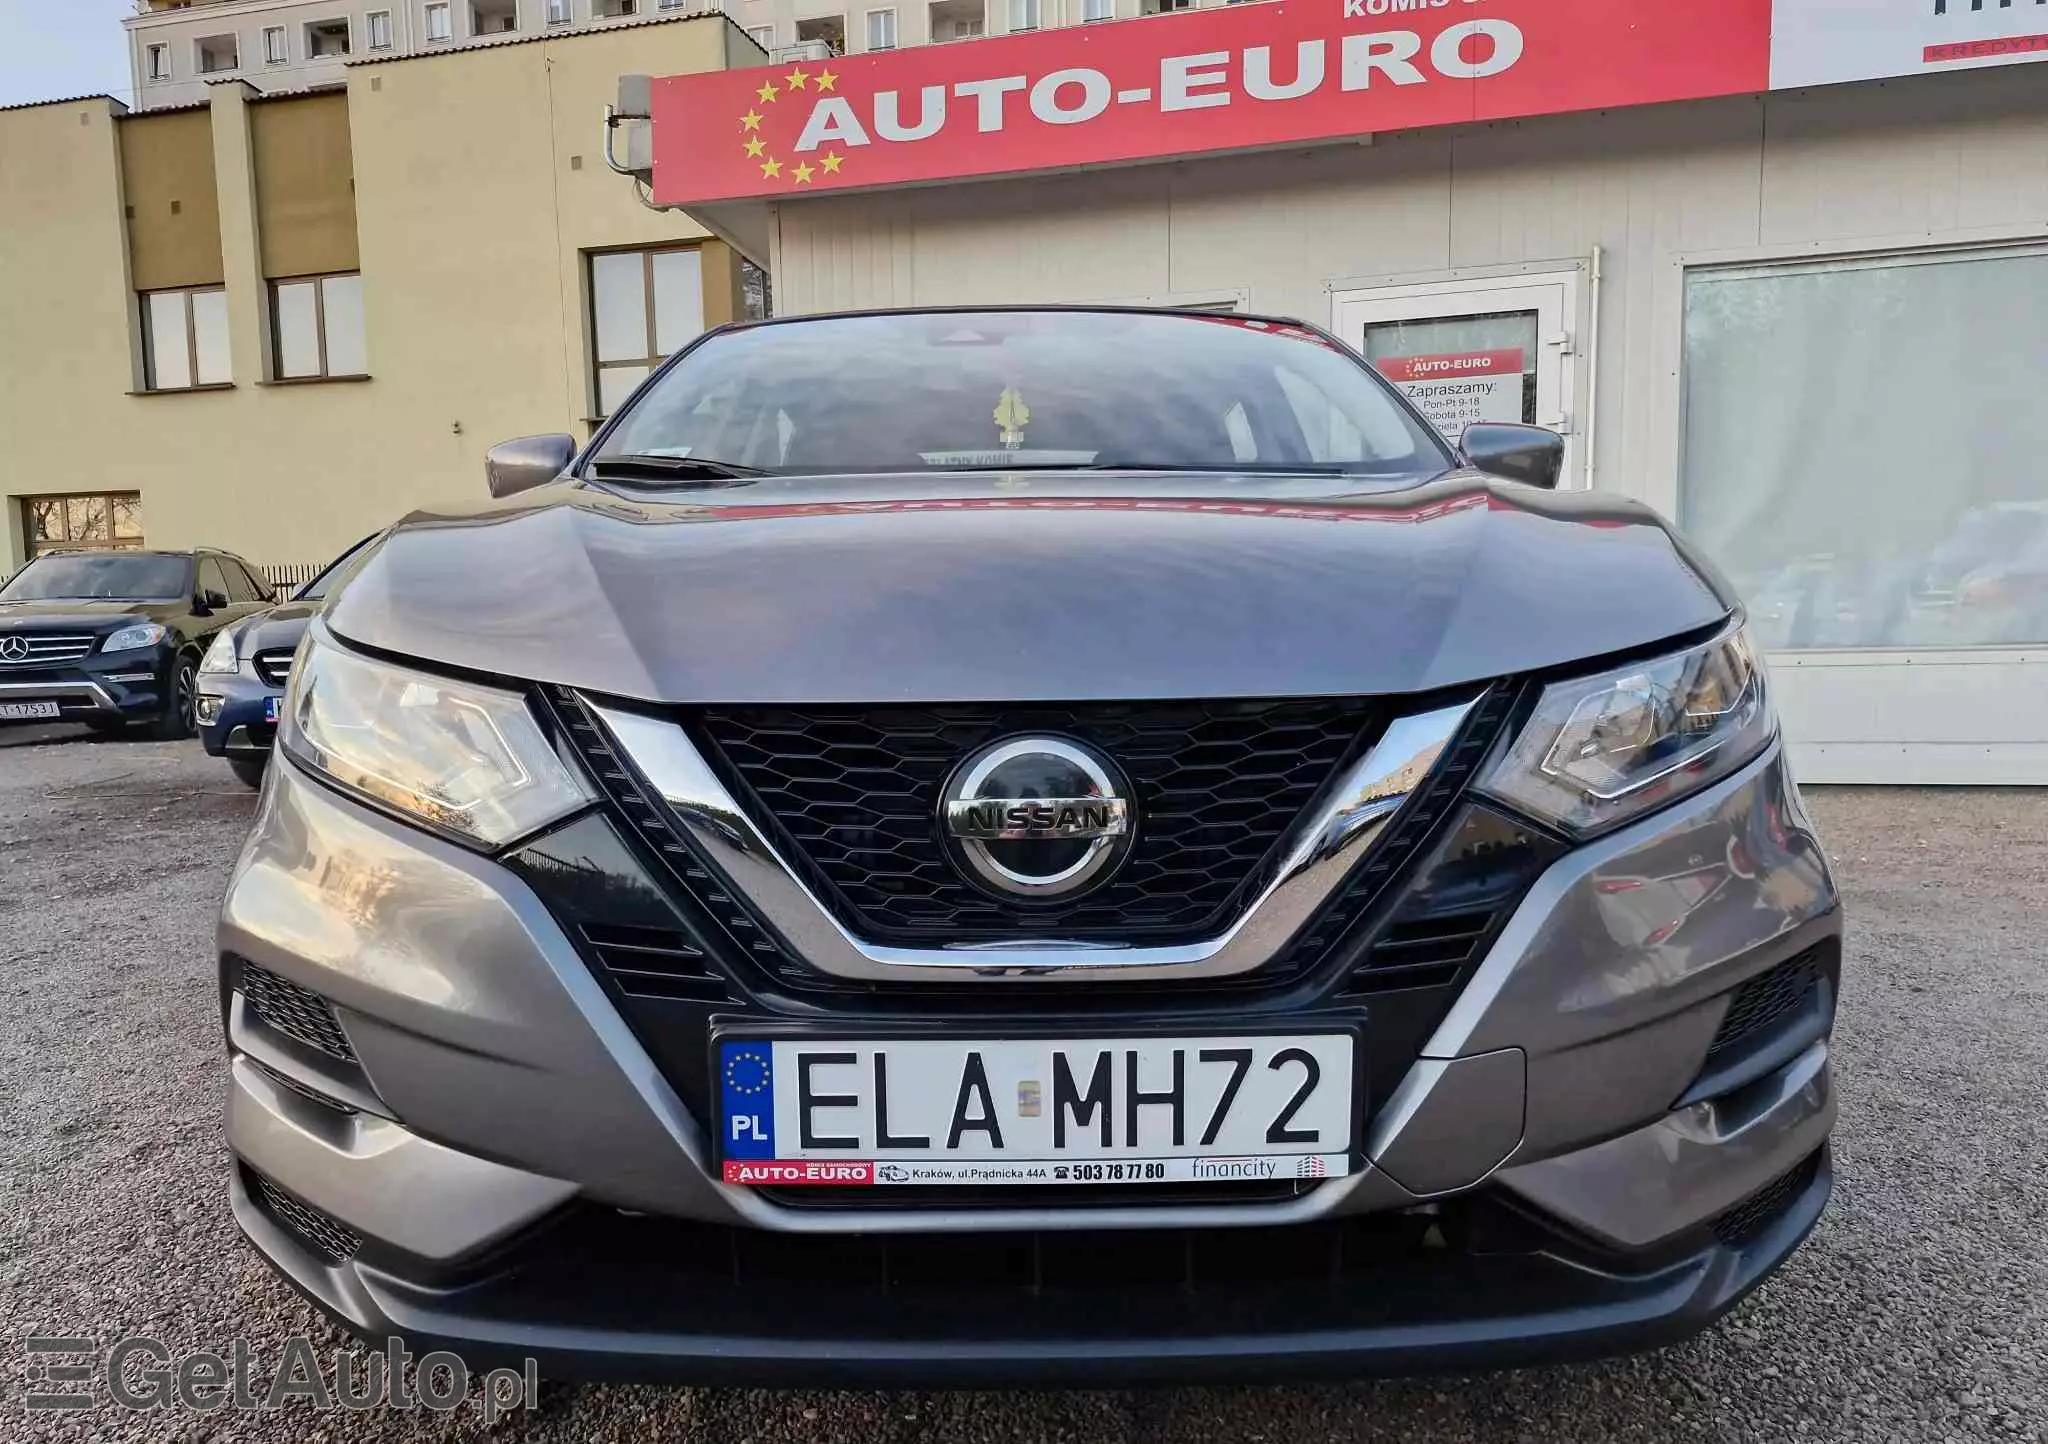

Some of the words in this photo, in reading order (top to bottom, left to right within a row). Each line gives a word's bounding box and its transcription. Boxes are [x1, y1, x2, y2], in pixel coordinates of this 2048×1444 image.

[1343, 0, 1450, 19] KOM
[1932, 37, 2048, 57] KREDYT
[793, 18, 1525, 153] AUTO-EURO
[1412, 357, 1492, 373] AUTO-EURO
[1407, 382, 1497, 399] Zapraszamy:
[1458, 396, 1480, 407] 9-18
[1458, 408, 1480, 418] 9-15
[967, 806, 1108, 831] NISSAN
[797, 1051, 1005, 1149] ELA
[1052, 1048, 1322, 1149] MH72
[732, 1115, 768, 1141] PL
[738, 1166, 867, 1181] AUTO-EURO
[912, 1167, 955, 1180] Kraków,
[1026, 1168, 1047, 1178] 44A
[1073, 1163, 1103, 1180] 503
[1105, 1164, 1124, 1180] 78
[1126, 1164, 1143, 1179] 77
[1145, 1163, 1165, 1178] 80
[1192, 1157, 1277, 1180] financity
